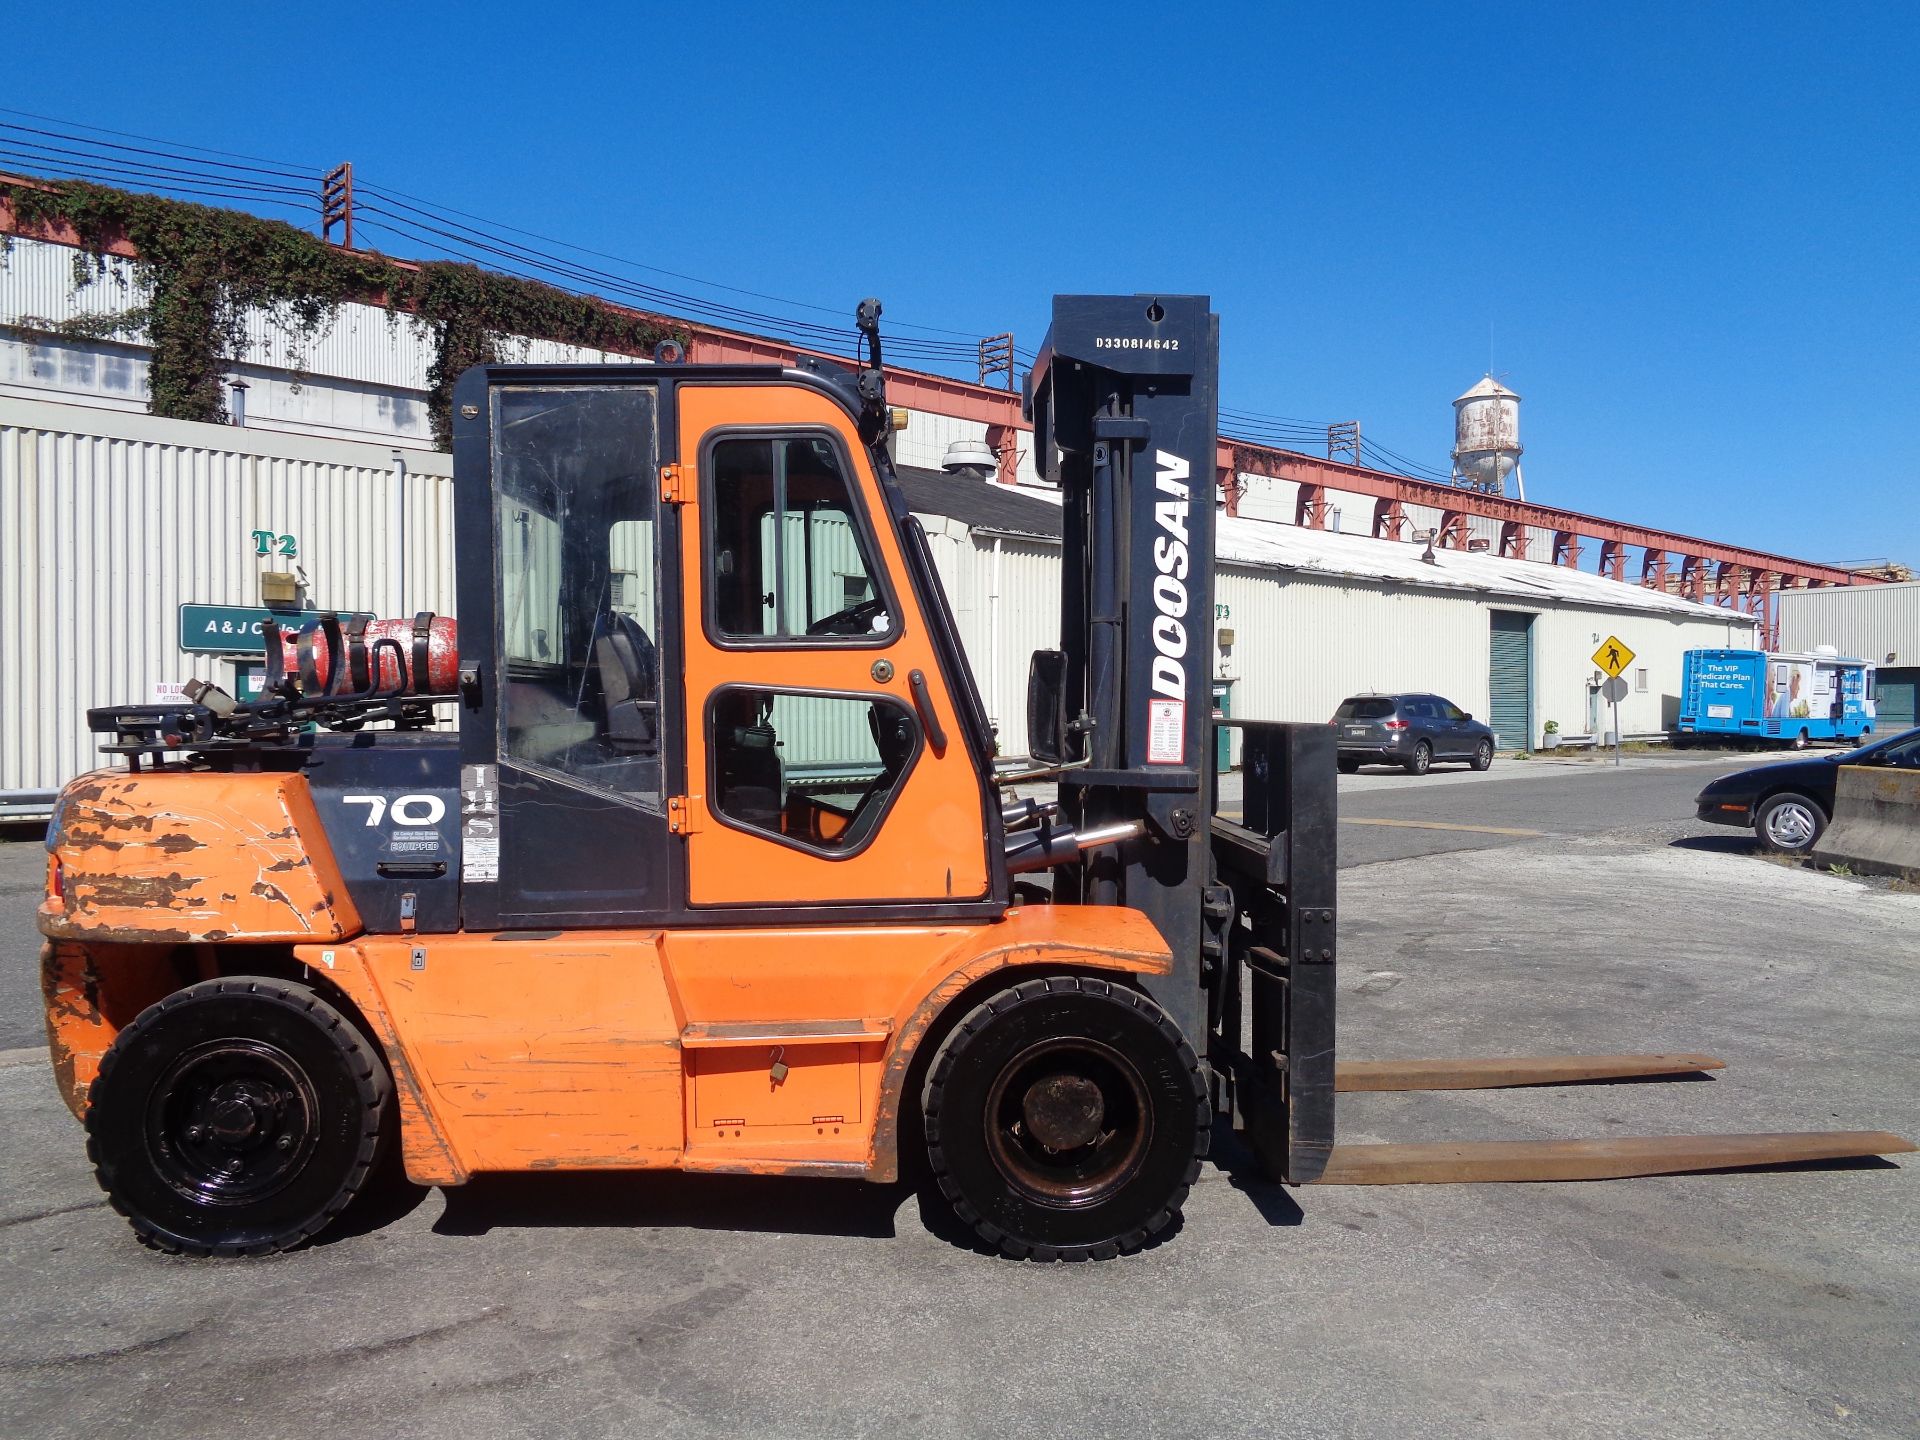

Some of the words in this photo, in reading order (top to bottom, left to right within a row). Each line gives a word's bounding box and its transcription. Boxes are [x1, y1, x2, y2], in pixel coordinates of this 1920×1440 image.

[1096, 338, 1179, 350] D330814642
[1152, 449, 1190, 701] DOOSAN
[205, 620, 217, 633] A
[221, 621, 233, 634] &
[237, 622, 247, 634] J
[156, 685, 168, 693] NO
[343, 795, 446, 827] 70
